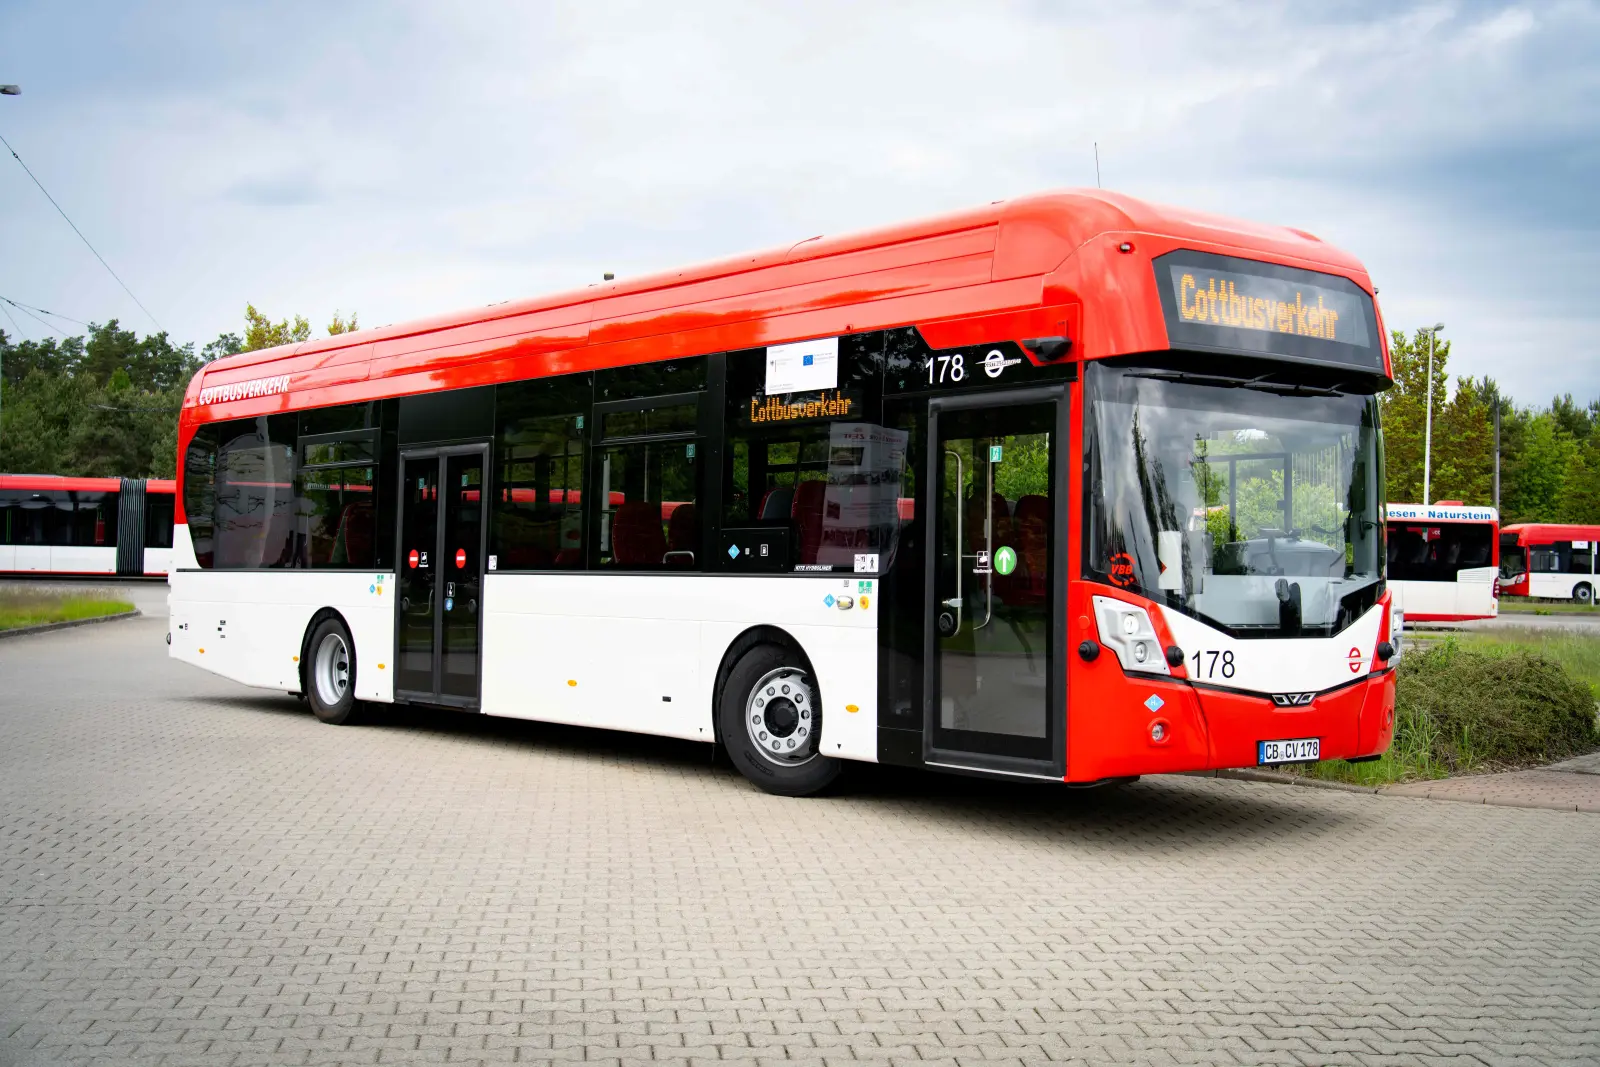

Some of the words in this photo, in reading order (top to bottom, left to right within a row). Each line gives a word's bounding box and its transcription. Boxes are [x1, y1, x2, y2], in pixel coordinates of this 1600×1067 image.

[1180, 274, 1339, 339] Cottbusverkehr
[925, 354, 964, 384] 178
[199, 375, 290, 405] COTTBUSVERKEHR
[751, 391, 852, 422] Cottbusverkehr
[1428, 510, 1491, 520] Naturstein
[1111, 564, 1133, 575] VBB
[1192, 650, 1235, 679] 178
[1265, 744, 1279, 760] CB
[1285, 742, 1299, 758] CV
[1300, 741, 1318, 757] 178
